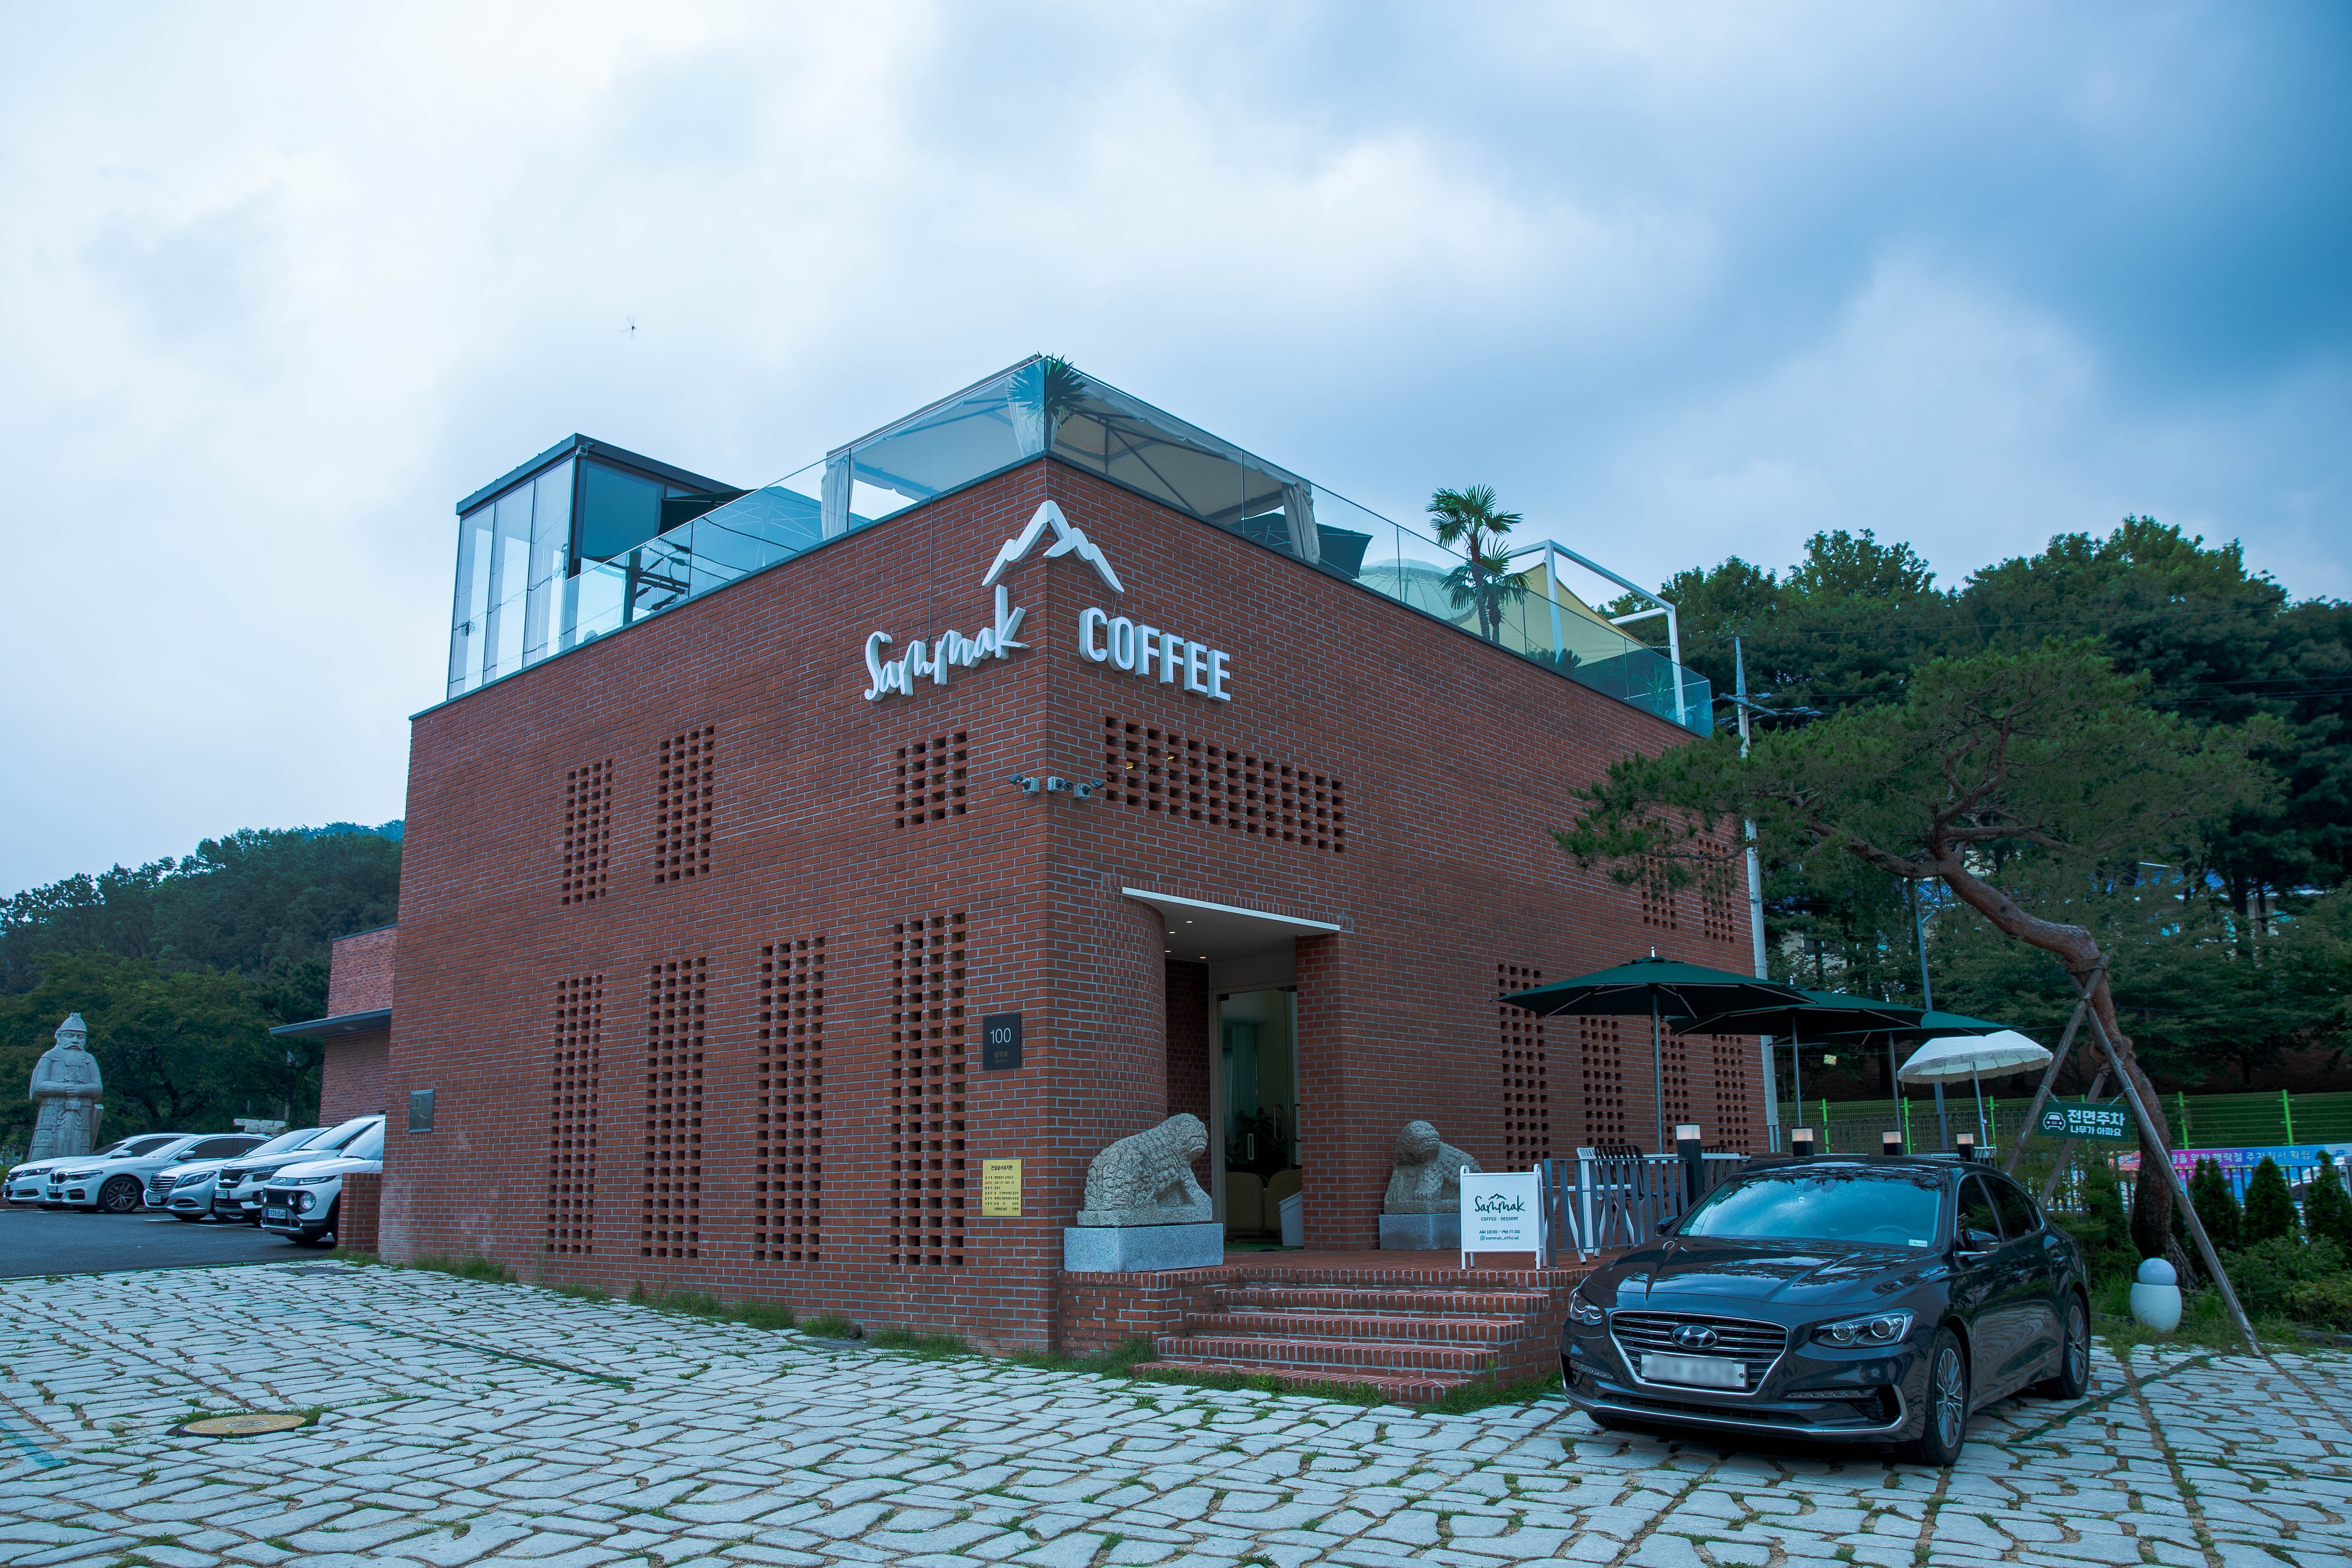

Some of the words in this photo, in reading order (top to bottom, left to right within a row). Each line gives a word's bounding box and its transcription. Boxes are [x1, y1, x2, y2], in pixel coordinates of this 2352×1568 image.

[865, 584, 1030, 701] Sammak
[1079, 607, 1231, 703] COFFEE
[990, 1028, 1011, 1044] 100
[2067, 1109, 2125, 1126] 전면주차
[2070, 1125, 2095, 1135] 나무가
[2097, 1127, 2122, 1136] 아파요
[1475, 1195, 1526, 1213] Sammak
